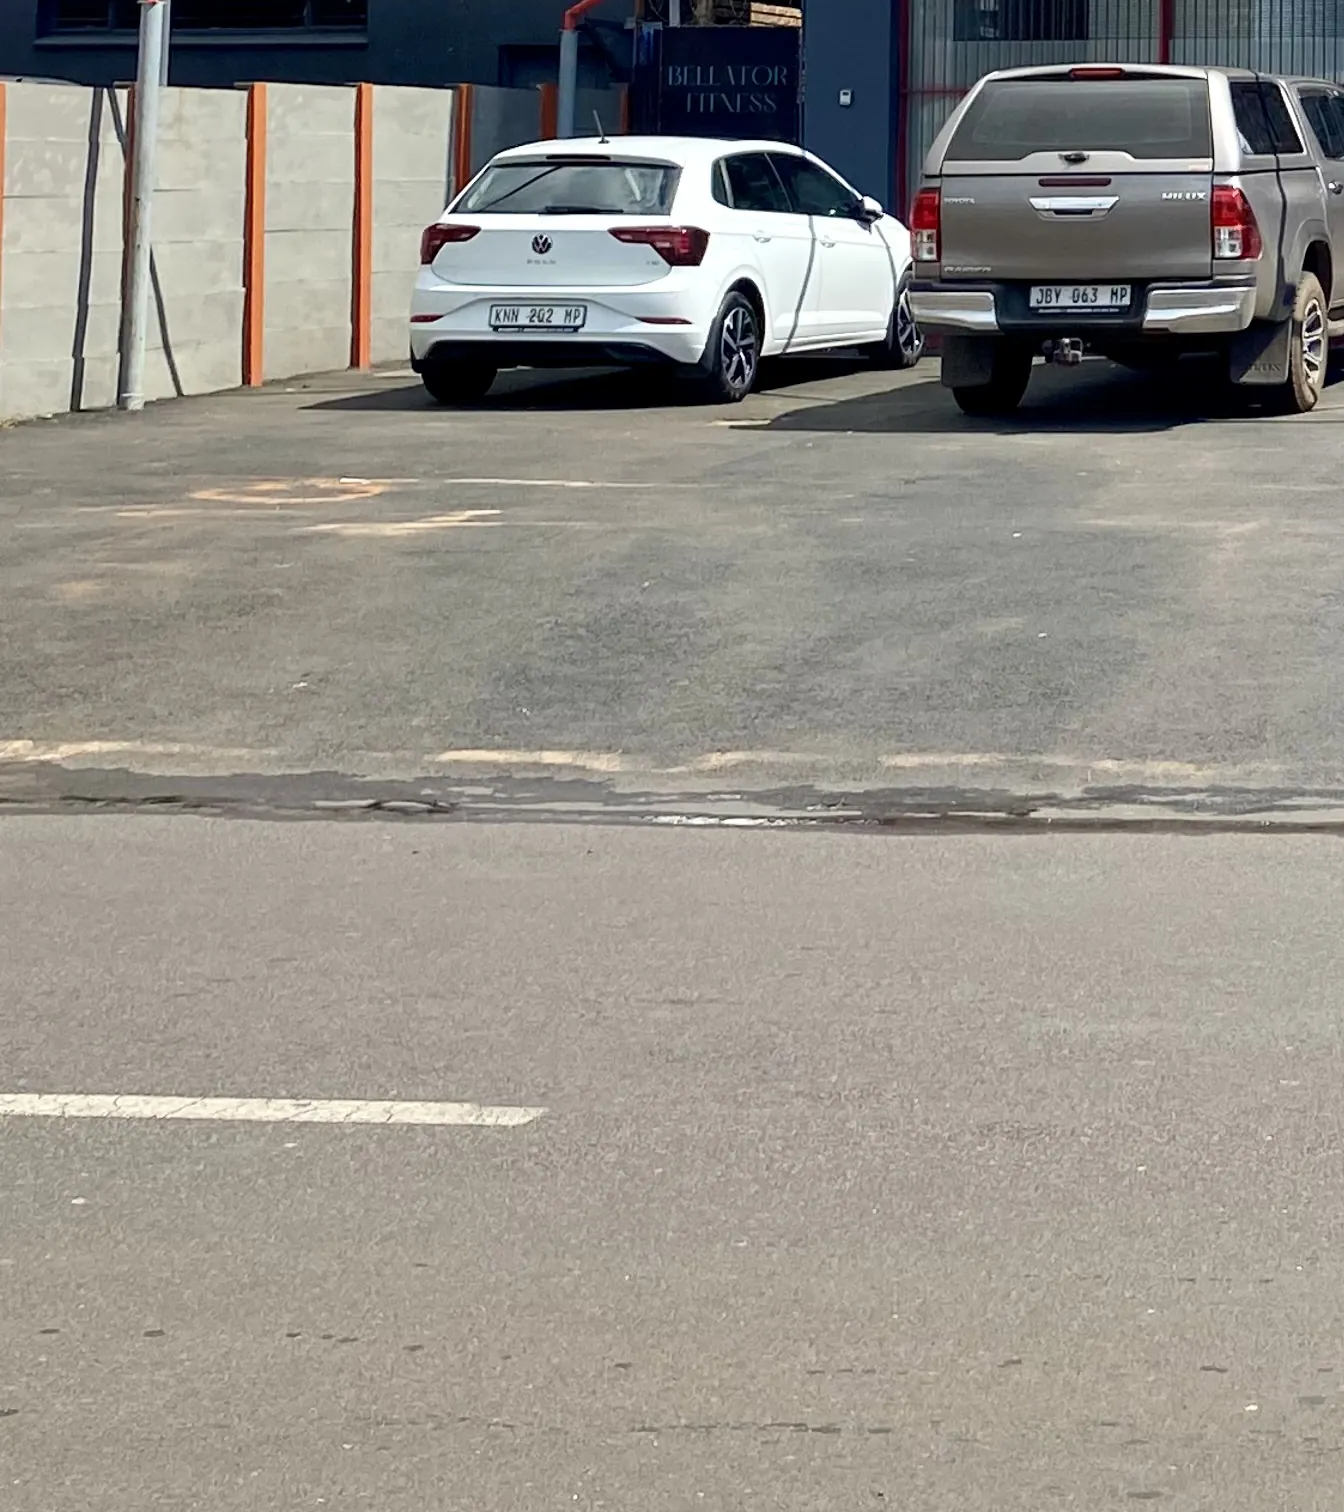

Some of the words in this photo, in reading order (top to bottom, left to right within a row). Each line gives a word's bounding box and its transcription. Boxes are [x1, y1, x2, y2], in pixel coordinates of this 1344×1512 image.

[668, 65, 788, 86] BELLATOR
[686, 93, 777, 113] FITNESS
[1036, 288, 1062, 305] JBY
[1072, 287, 1099, 304] 063
[1110, 287, 1128, 304] MP
[494, 308, 519, 323] KNN
[563, 308, 581, 323] MP
